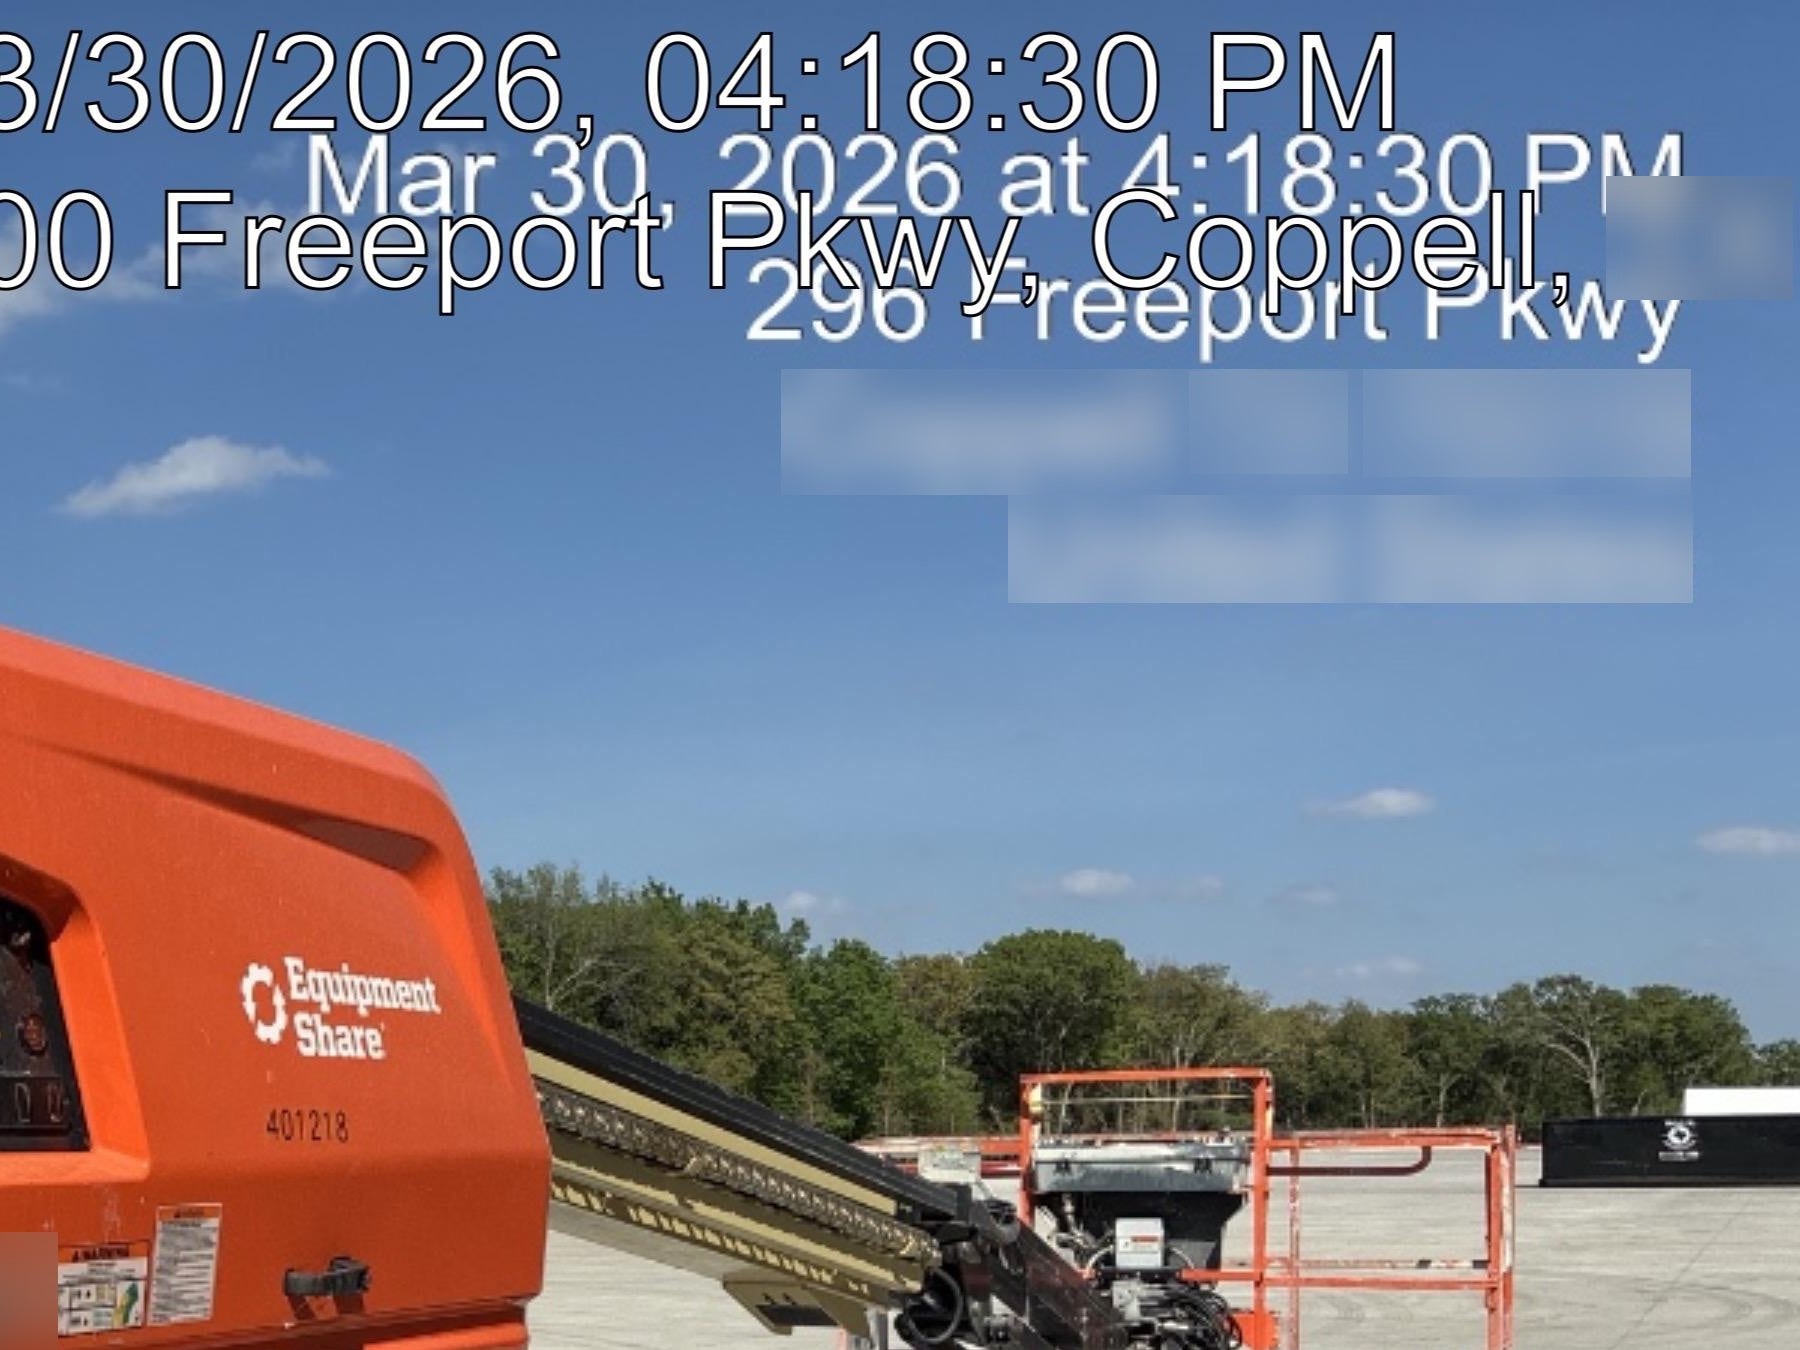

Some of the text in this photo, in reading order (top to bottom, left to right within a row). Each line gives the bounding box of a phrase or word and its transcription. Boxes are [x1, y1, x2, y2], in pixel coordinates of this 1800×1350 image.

[283, 956, 442, 1018] Equipment
[293, 1010, 387, 1060] Share
[266, 1108, 350, 1143] 401218
